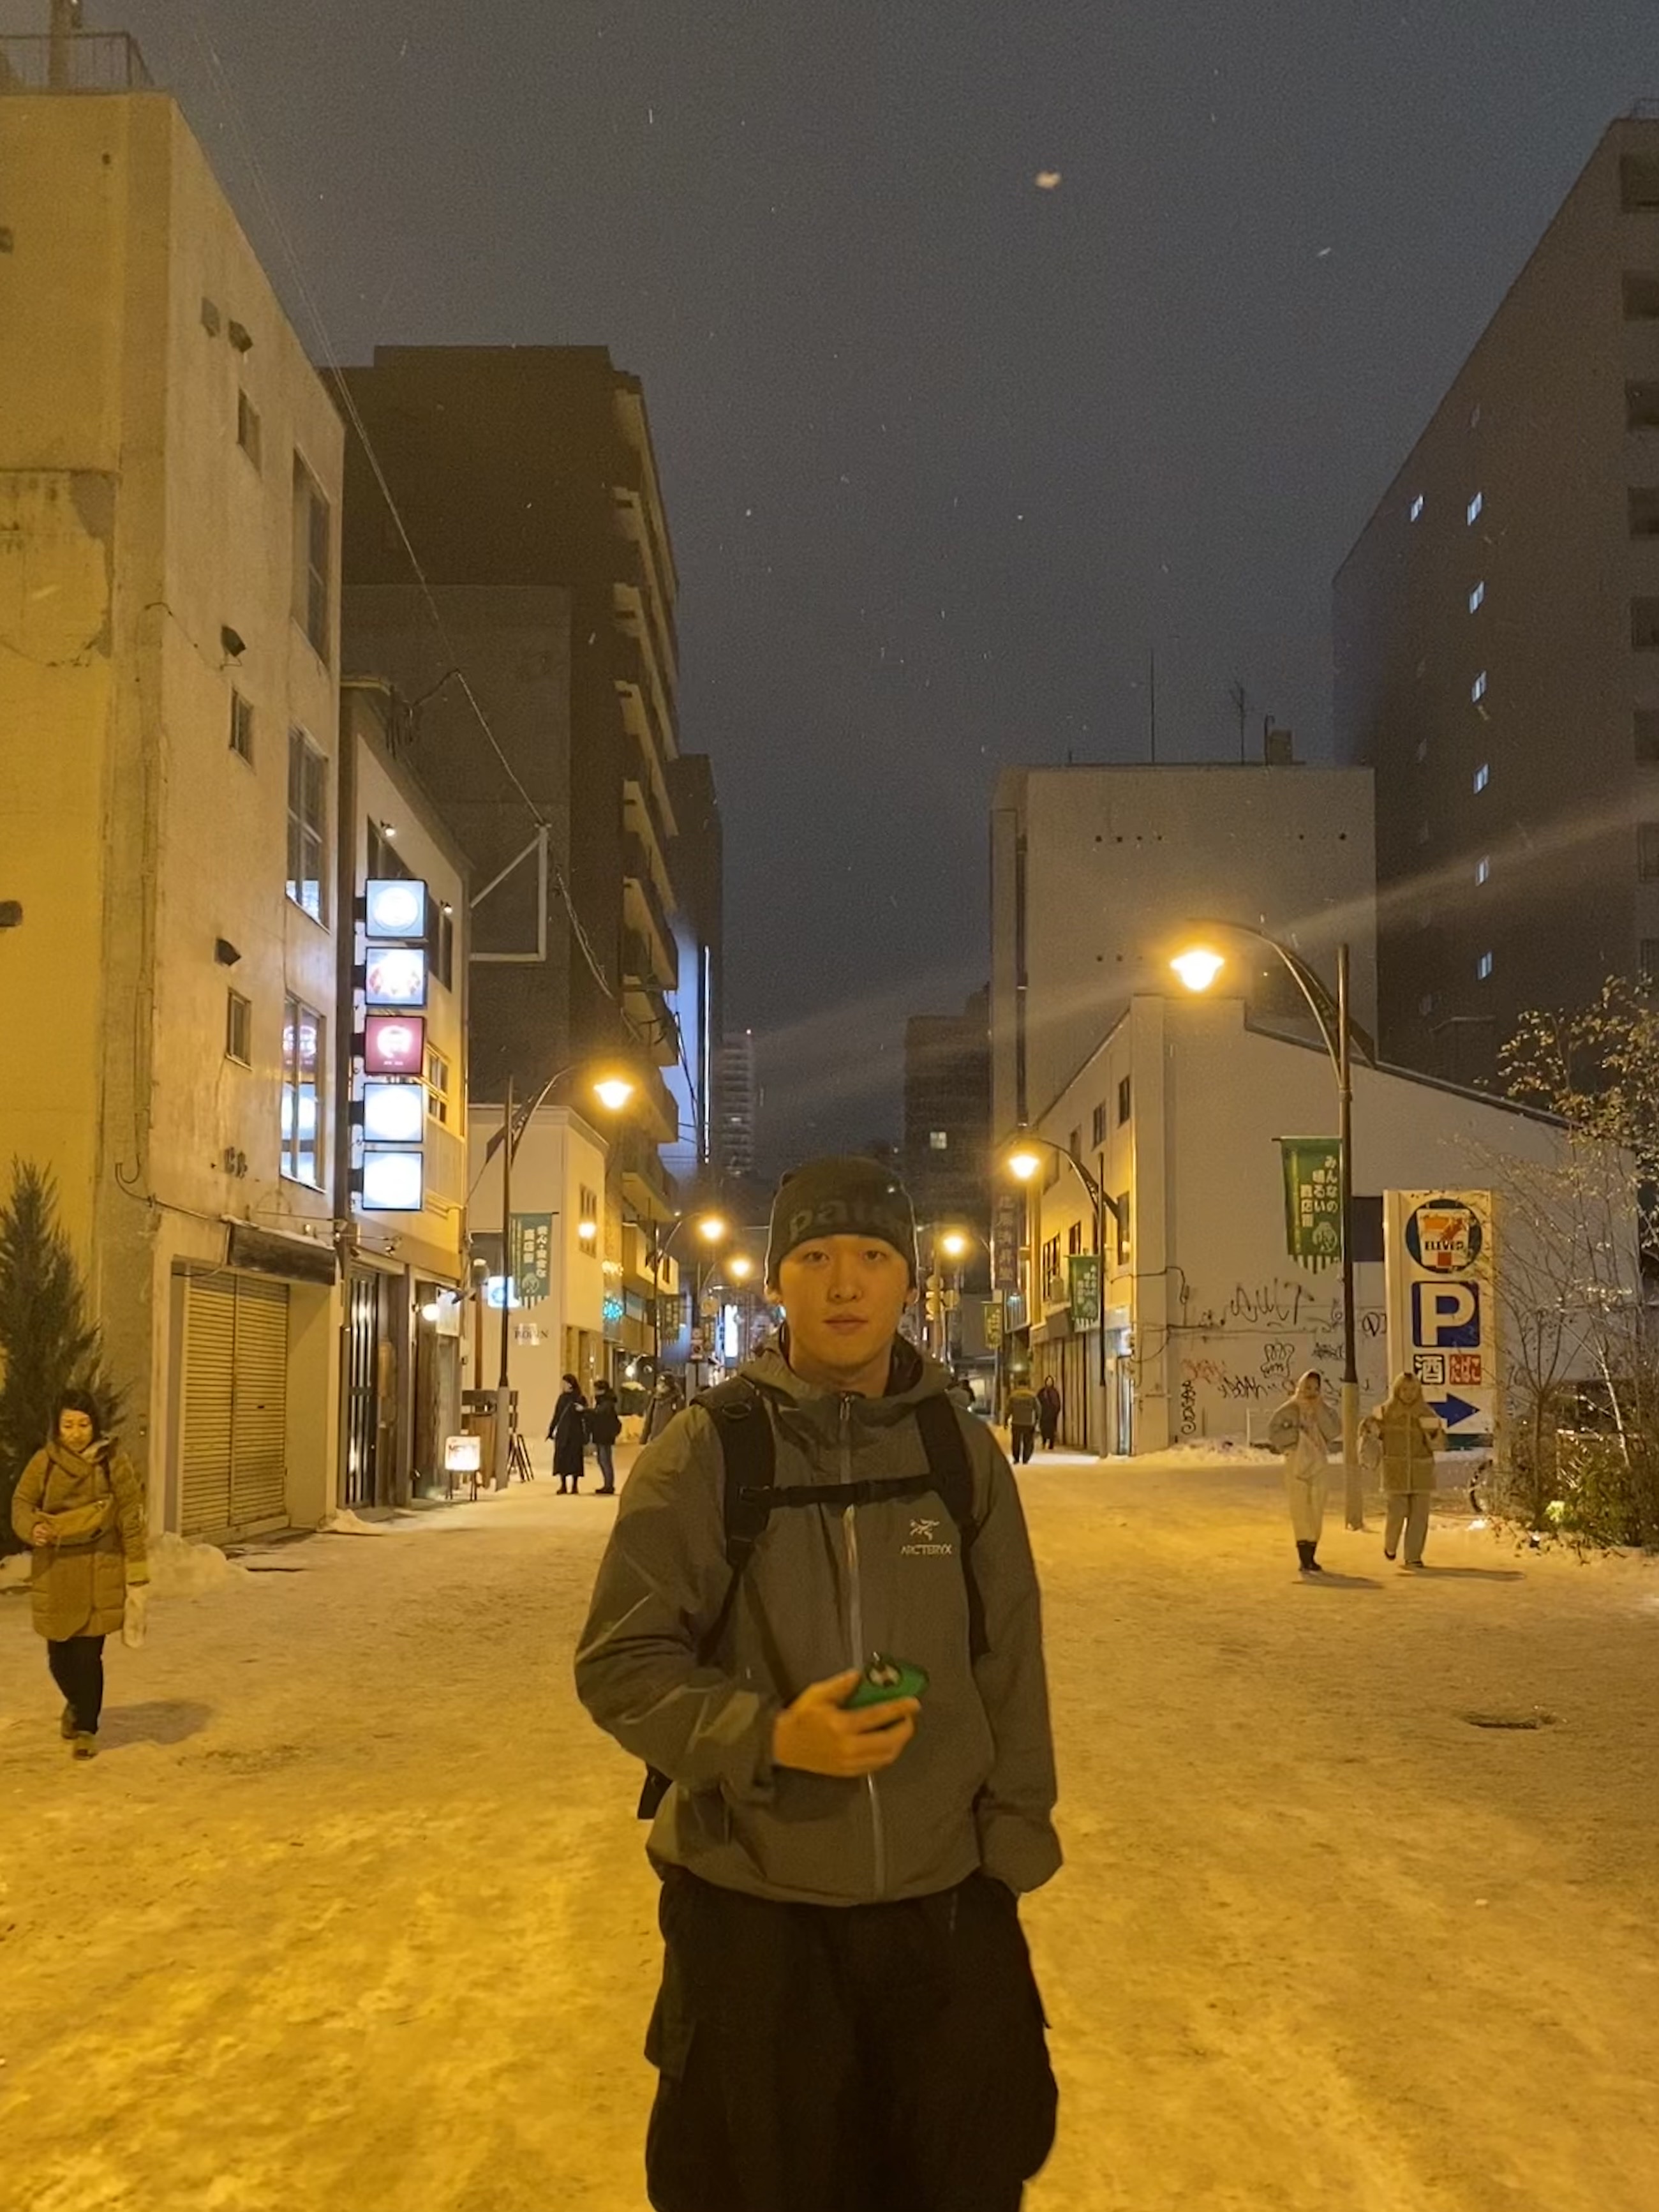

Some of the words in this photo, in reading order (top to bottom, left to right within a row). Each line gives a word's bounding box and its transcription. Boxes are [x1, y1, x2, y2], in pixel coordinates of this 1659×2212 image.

[1325, 1155, 1337, 1213] みんなの
[1420, 1283, 1475, 1345] P
[1415, 1356, 1443, 1383] 酒
[1450, 1356, 1480, 1383] たばこ
